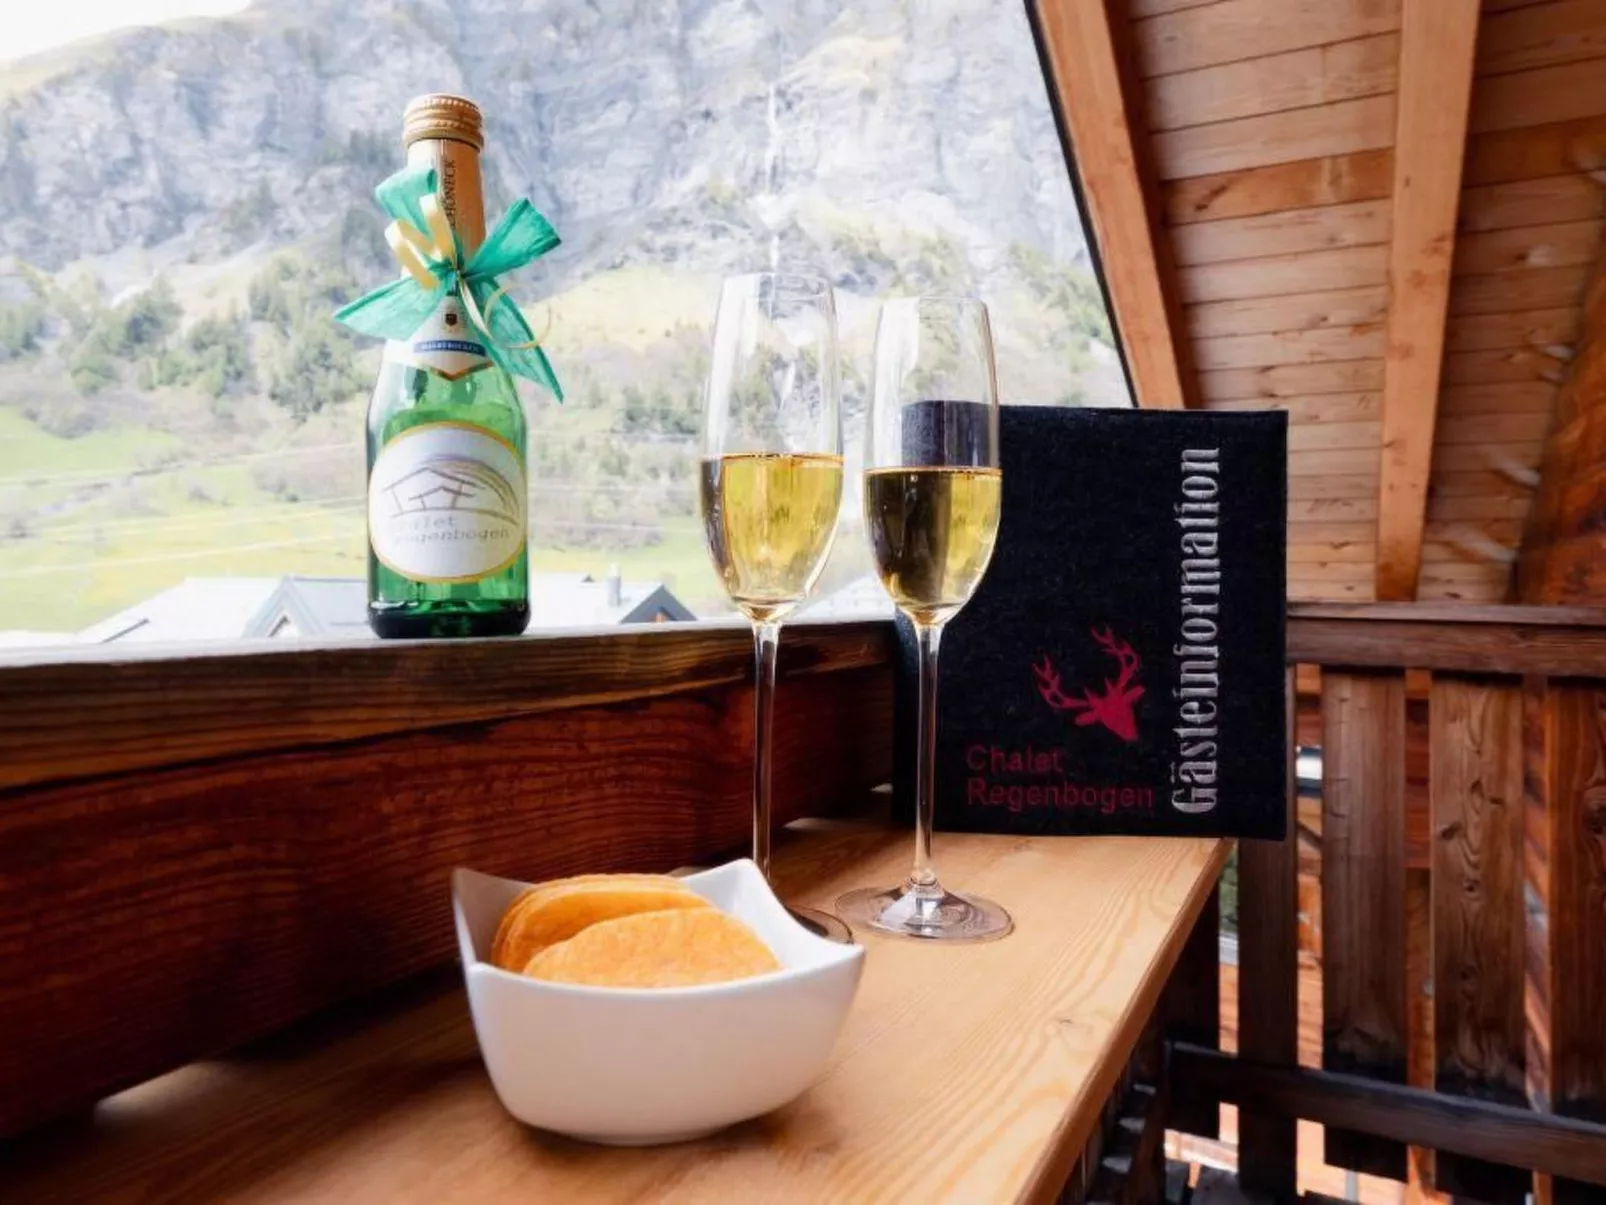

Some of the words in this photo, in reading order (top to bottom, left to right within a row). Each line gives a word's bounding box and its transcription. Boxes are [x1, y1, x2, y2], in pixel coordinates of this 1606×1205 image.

[1171, 447, 1222, 814] Gästeinformation
[966, 744, 1064, 774] Chalet
[967, 776, 1155, 815] Regenbogen
